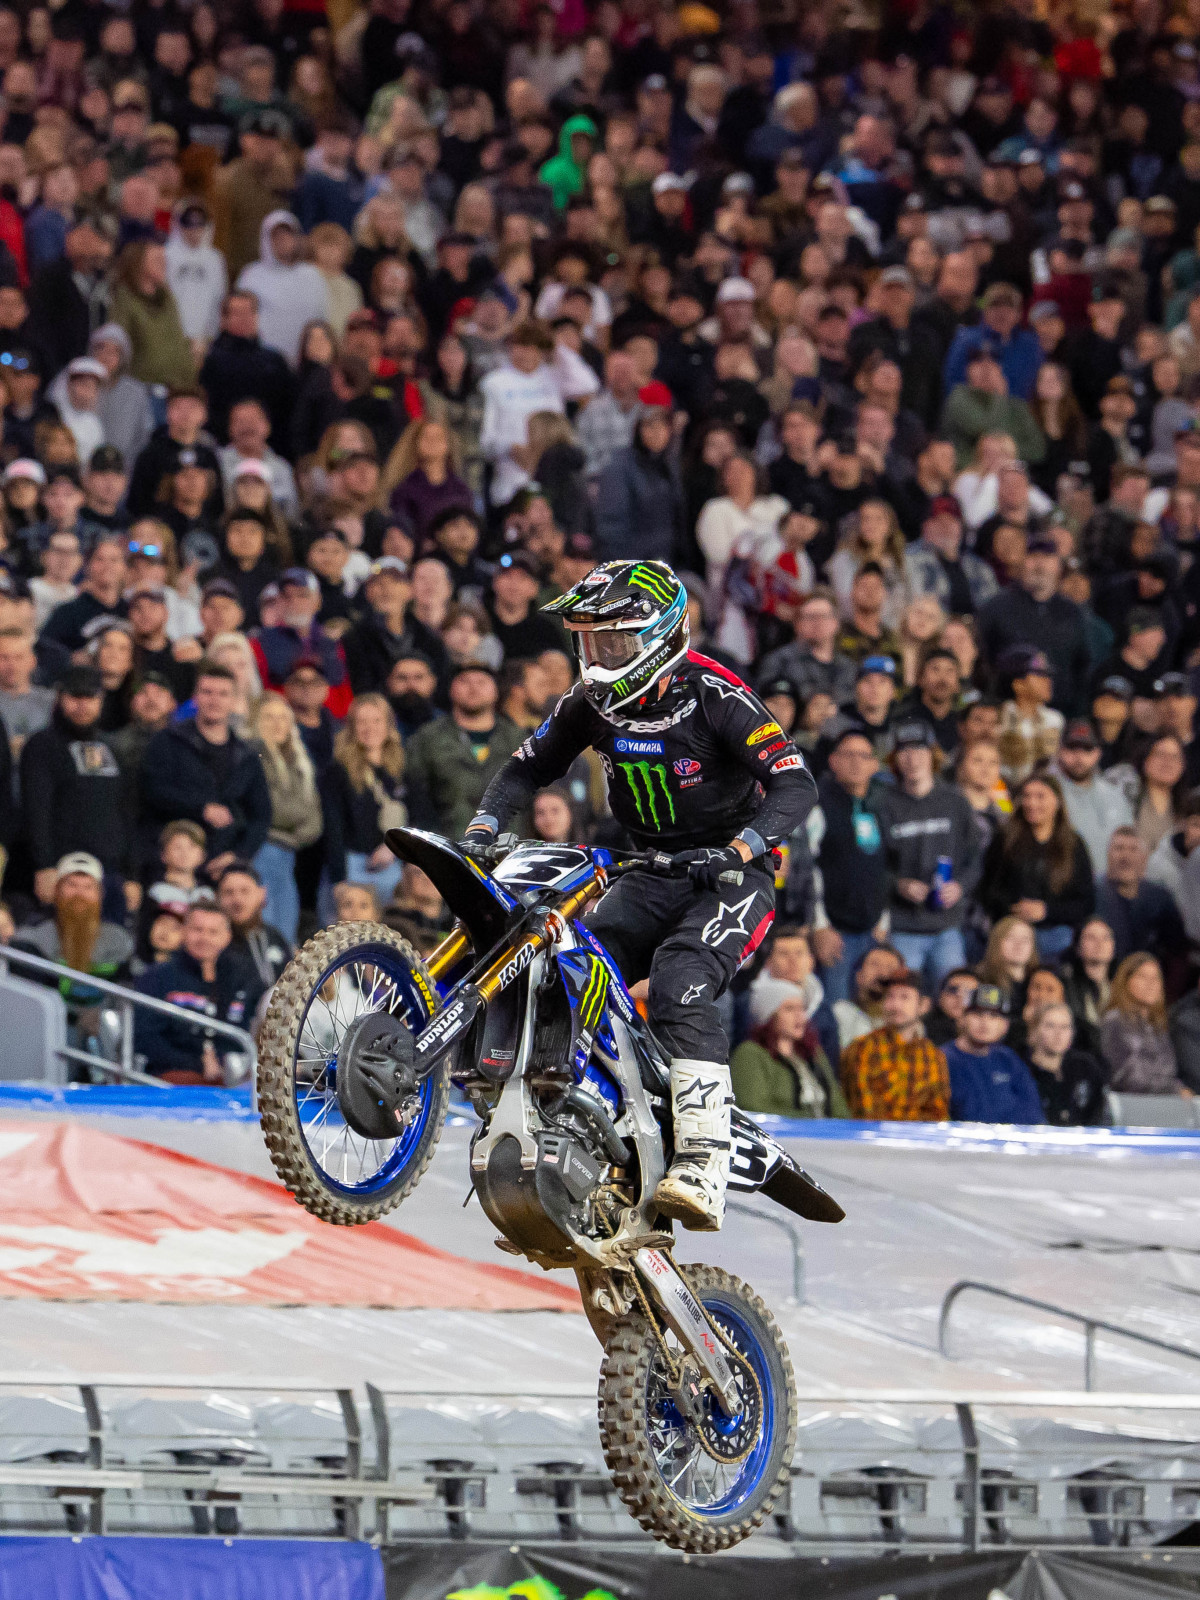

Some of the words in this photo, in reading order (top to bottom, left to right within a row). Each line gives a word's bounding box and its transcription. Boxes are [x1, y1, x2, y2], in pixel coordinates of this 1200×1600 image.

[629, 645, 672, 681] MONSTER
[628, 741, 662, 753] YAMAHA
[498, 942, 536, 991] KYB
[416, 1002, 464, 1052] DUNLOP
